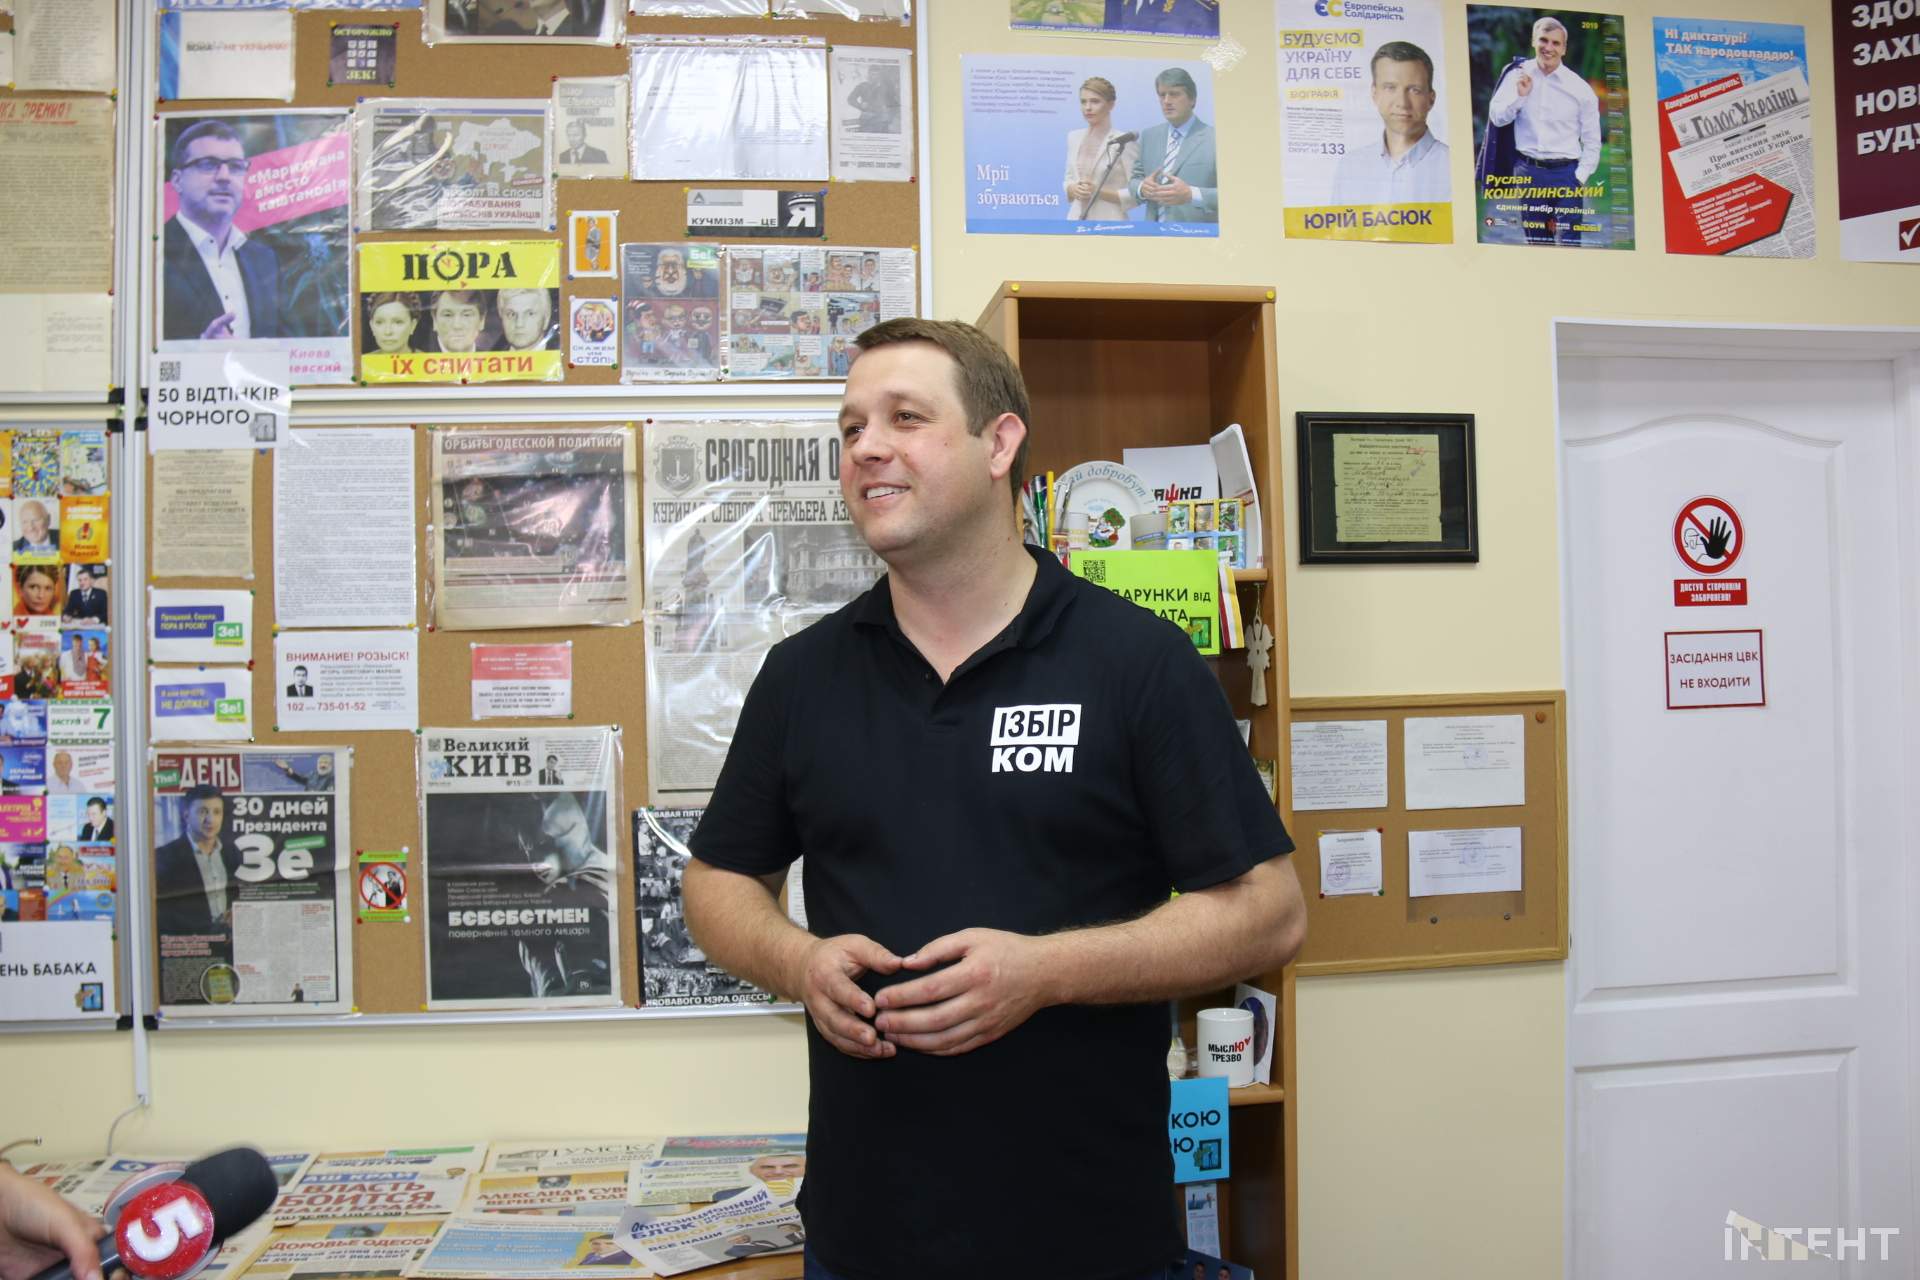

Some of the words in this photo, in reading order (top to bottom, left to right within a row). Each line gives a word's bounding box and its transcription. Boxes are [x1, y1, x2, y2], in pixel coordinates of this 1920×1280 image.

[1344, 1, 1404, 13] Європейська
[1344, 10, 1405, 20] Солідарність
[1283, 32, 1361, 47] БУДУЄМО
[1681, 30, 1747, 44] диктатурі!
[1285, 49, 1352, 64] УКРАЇНУ
[1665, 42, 1693, 55] ТАК
[1695, 46, 1795, 61] народовладдю!
[1286, 68, 1321, 82] ДЛЯ
[1324, 67, 1362, 80] СЕБЕ
[1855, 84, 1920, 117] НОВ
[1320, 142, 1346, 155] 133
[976, 164, 1010, 185] Мрії
[1485, 174, 1532, 186] Руслан
[976, 188, 1060, 210] збуваються
[1484, 183, 1604, 200] КОШУЛИНСЬКИЙ
[691, 217, 744, 227] КУЧМІЗМ
[761, 216, 777, 228] ЦЕ
[786, 201, 817, 228] Я
[1529, 204, 1553, 214] вибір
[1304, 209, 1357, 229] ЮРІЙ
[1362, 209, 1433, 227] БАСЮК
[402, 250, 517, 282] ПОРА
[288, 362, 342, 373] евский
[391, 355, 413, 375] їх
[158, 388, 179, 403] 50
[186, 386, 279, 404] ВІДТІНКІВ
[157, 409, 250, 426] ЧОРНОГО
[494, 436, 555, 450] ОДЕССКОЙ
[558, 436, 623, 449] ПОЛИТИКИ
[705, 437, 820, 489] СВОБОДНАЯ
[829, 437, 842, 482] О
[1087, 464, 1147, 497] добробут
[1152, 483, 1202, 503] ЯШКО
[768, 500, 826, 522] ПРЕМЬЕРА
[1152, 609, 1188, 621] АТА
[217, 625, 240, 637] Зе!
[286, 652, 354, 662] ВНИМАНИЕ!
[357, 651, 409, 661] РОЗЫСК!
[1670, 652, 1733, 664] ЗАСІДАННЯ
[1736, 651, 1759, 663] ЦВК
[1680, 679, 1695, 689] НЕ
[1697, 677, 1751, 688] ВХОДИТИ
[287, 703, 304, 711] 102
[318, 702, 366, 711] 735-01-52
[93, 708, 111, 730] 7
[998, 709, 1076, 738] ІЗБІР
[444, 737, 530, 751] Великий
[444, 753, 533, 777] КИЇВ
[991, 746, 1075, 773] КОМ
[178, 757, 240, 790] ДЕНЬ
[232, 798, 264, 816] 30
[269, 797, 329, 818] дней
[232, 819, 328, 834] Президента
[234, 834, 315, 882] Зе
[0, 963, 28, 977] ЕНЬ
[33, 962, 96, 977] БАБАКА
[703, 995, 729, 1004] МЭРА
[731, 994, 771, 1004] ОДЕССЫ
[1211, 1053, 1242, 1063] ТРЕЗВО
[1171, 1109, 1221, 1130] КОЮ
[1173, 1137, 1194, 1154] Ю
[304, 1173, 341, 1181] АШ
[303, 1182, 426, 1194] ВЛАСТЬ
[277, 1191, 436, 1207] БОИТСЯ
[592, 1193, 627, 1201] ОДЕ
[126, 1195, 204, 1264] 5
[631, 1223, 697, 1240] БЛОК
[648, 1242, 678, 1252] ВСЕ
[681, 1231, 723, 1246] НАШИ
[757, 1214, 801, 1226] ВИЛКУ
[271, 1239, 360, 1250] ДОРОВЬЕ
